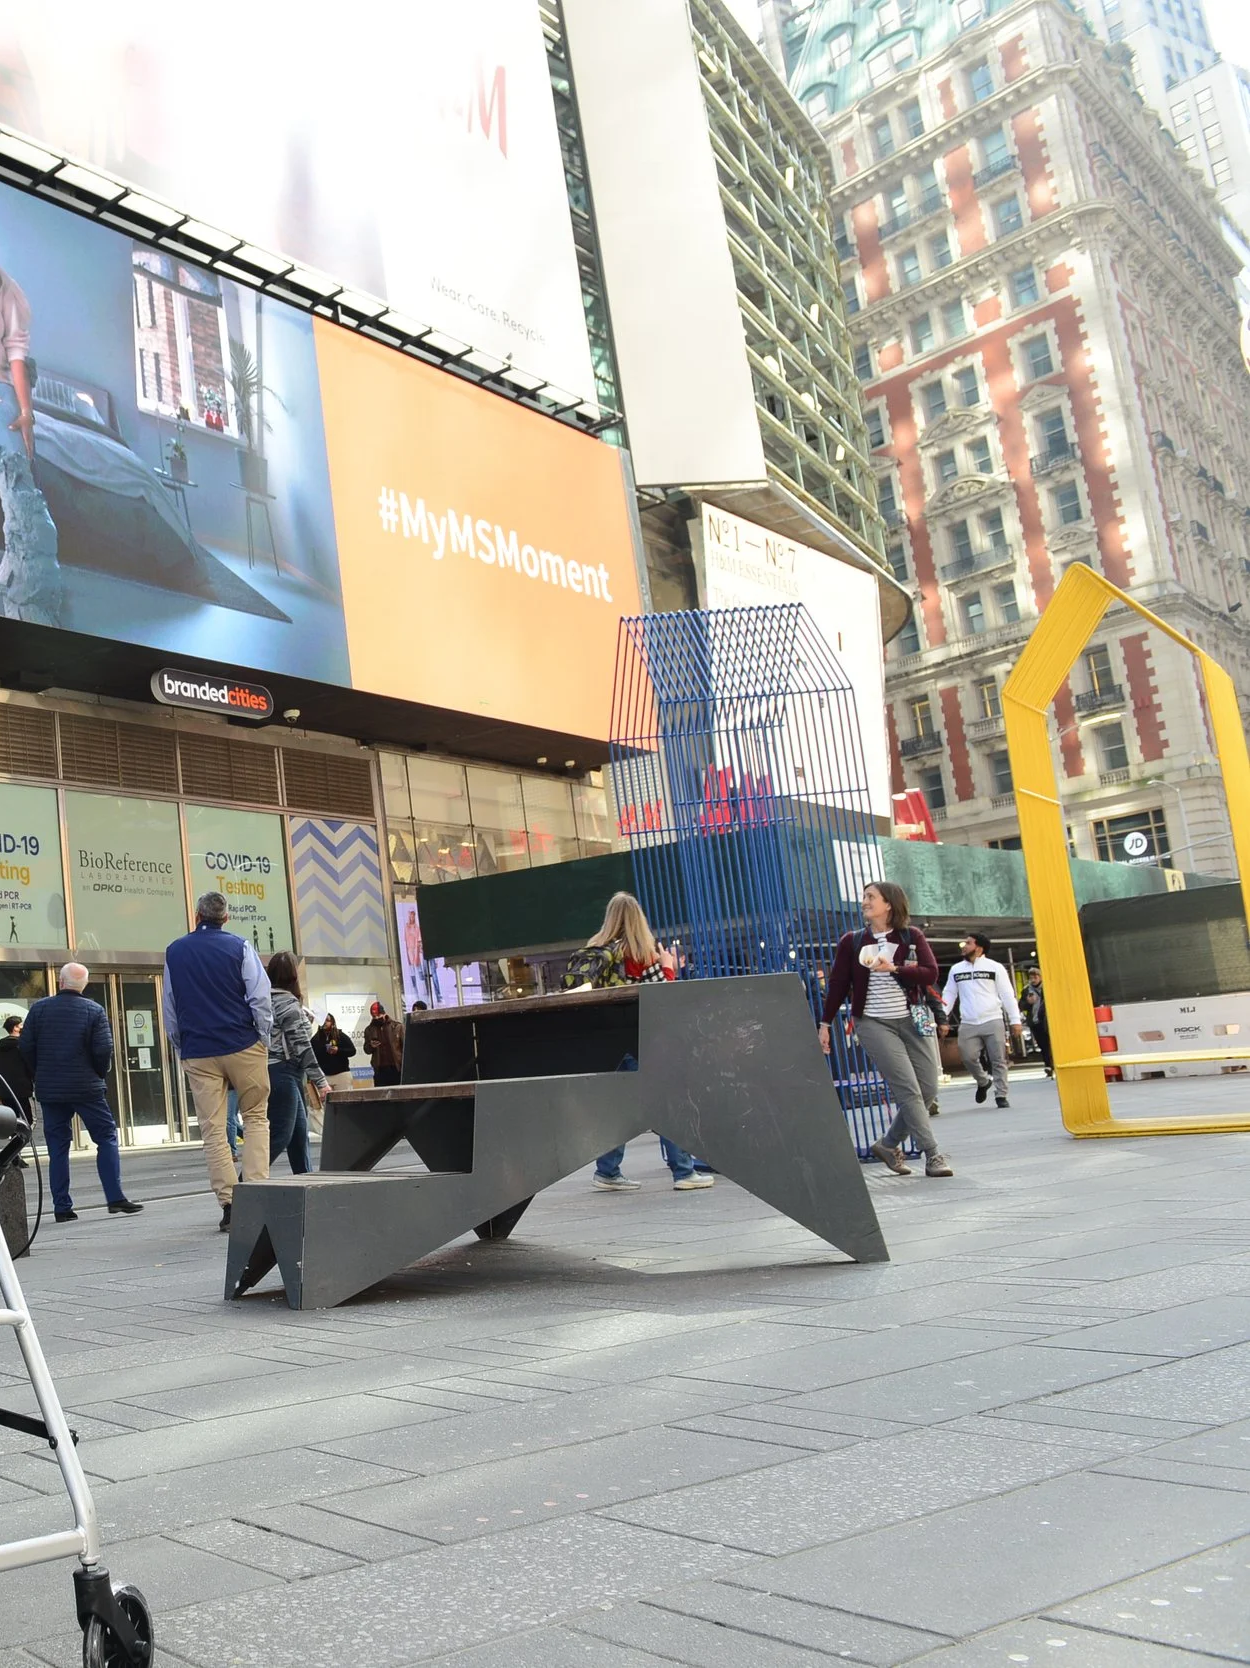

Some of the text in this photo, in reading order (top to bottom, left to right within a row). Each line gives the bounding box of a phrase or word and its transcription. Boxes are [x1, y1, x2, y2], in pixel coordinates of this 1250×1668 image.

[378, 486, 613, 603] #MyMSMoment
[1128, 837, 1143, 850] JD
[78, 849, 172, 874] BioReference
[205, 851, 271, 874] COVID-19
[80, 872, 174, 885] LABORATORIES
[93, 883, 123, 893] OPKO
[125, 886, 145, 895] Health
[147, 887, 174, 897] Company
[216, 875, 265, 900] Testing
[4, 891, 20, 900] PCR
[1174, 1026, 1201, 1034] ROCK
